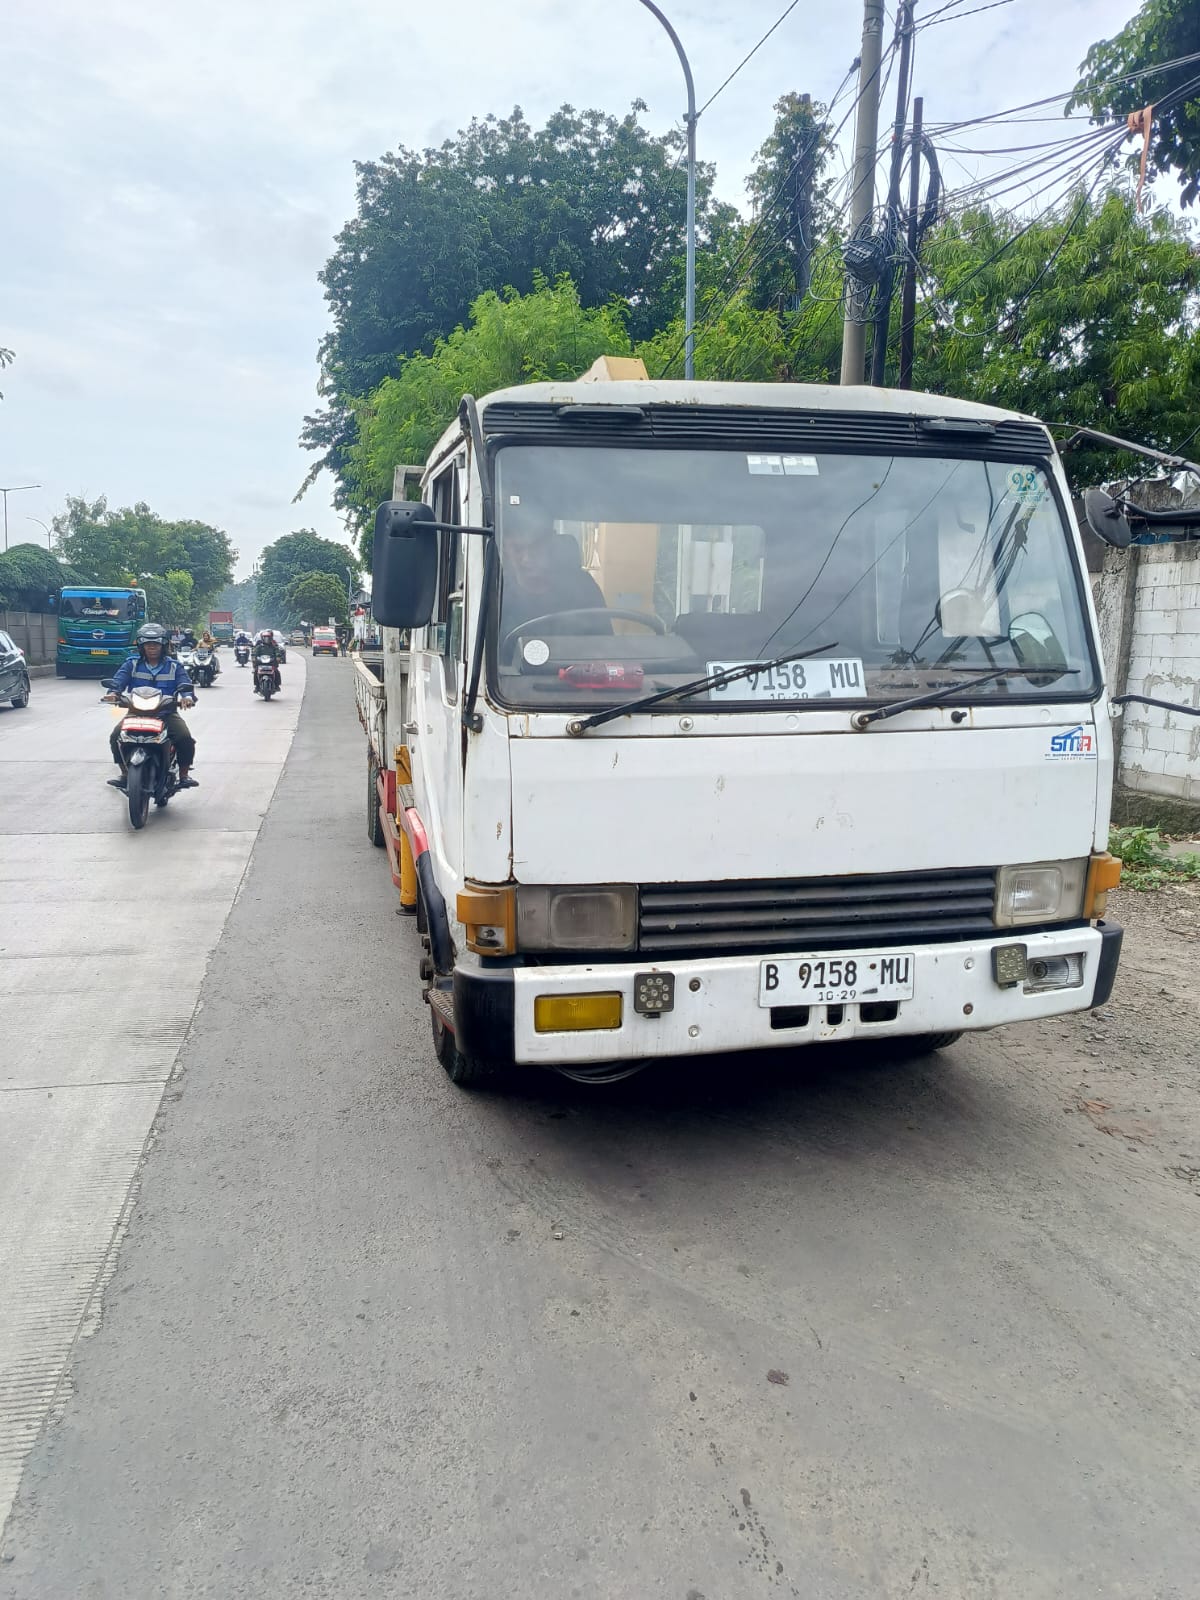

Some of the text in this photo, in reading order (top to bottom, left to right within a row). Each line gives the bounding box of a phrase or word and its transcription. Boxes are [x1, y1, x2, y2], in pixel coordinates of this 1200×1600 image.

[747, 663, 807, 691] 9158
[829, 662, 860, 688] MU
[765, 957, 909, 990] B 9158 MU
